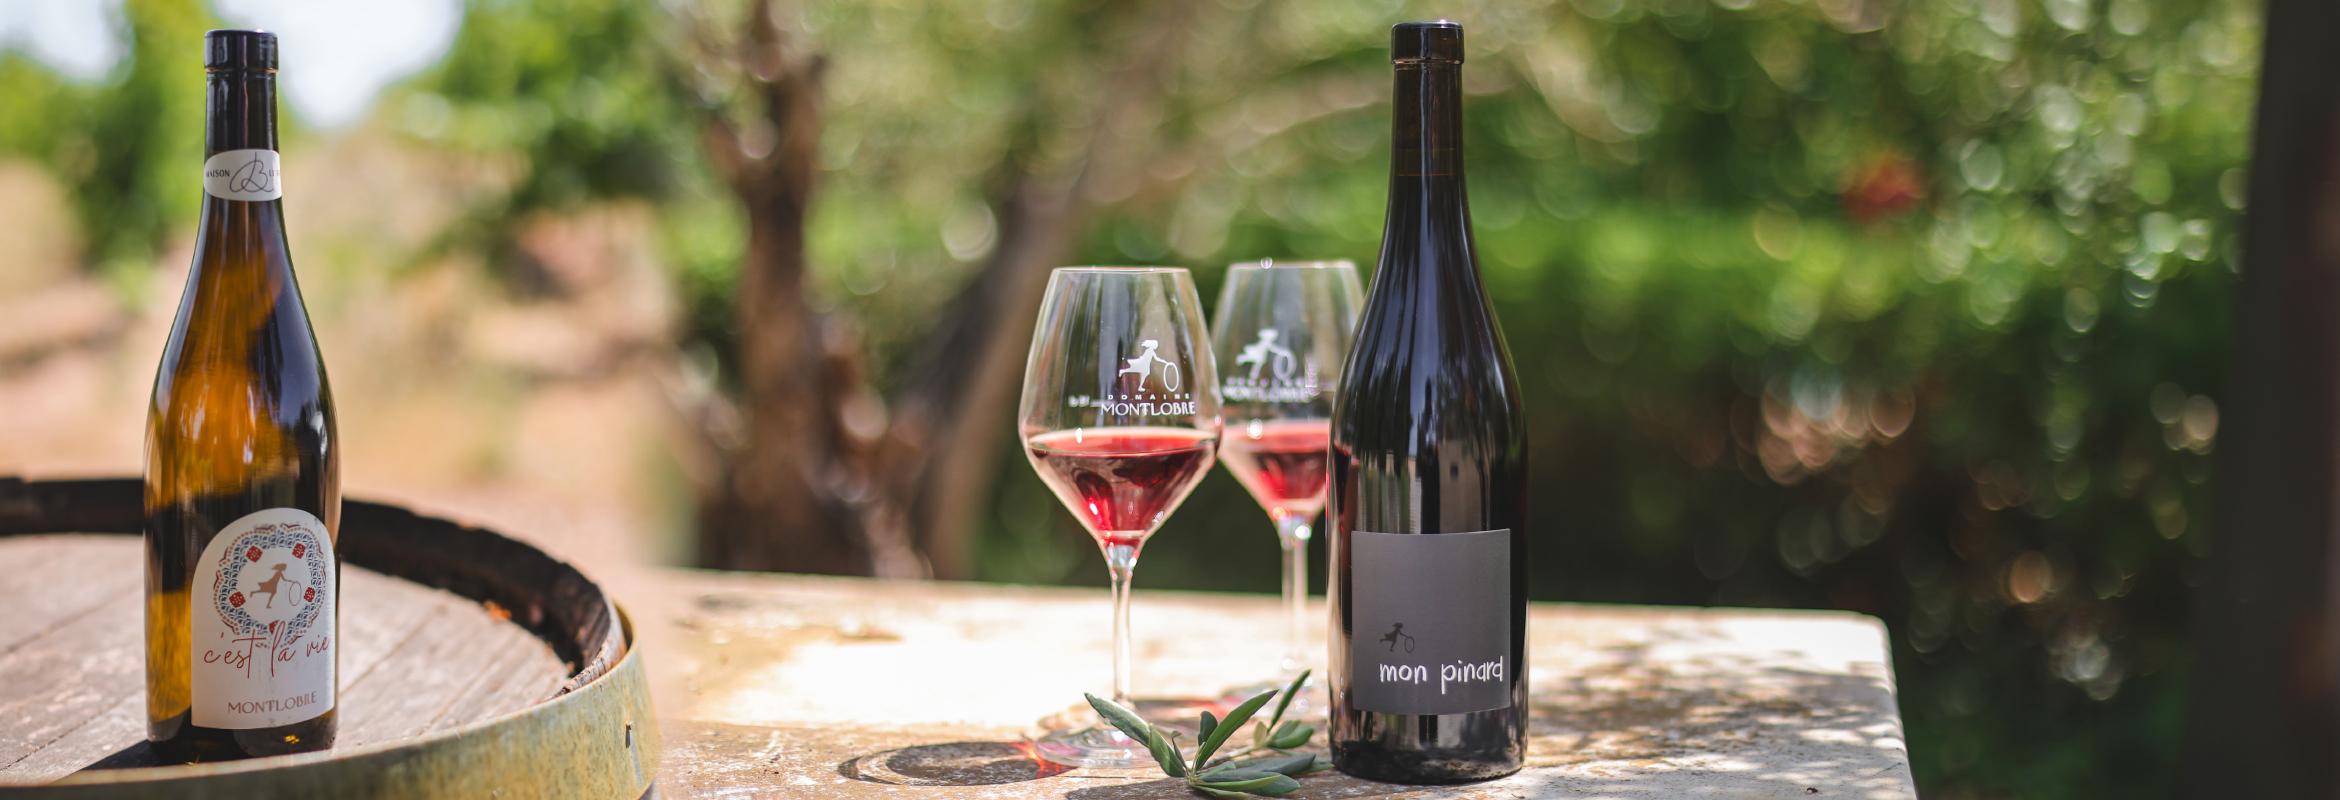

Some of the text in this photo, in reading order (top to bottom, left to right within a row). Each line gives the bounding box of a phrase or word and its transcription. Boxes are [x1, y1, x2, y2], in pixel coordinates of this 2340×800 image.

[1100, 401, 1197, 417] MONTLOBRE
[1108, 392, 1190, 401] DOMAINE
[203, 620, 330, 679] c'est la vie
[1379, 655, 1504, 695] mon pinard
